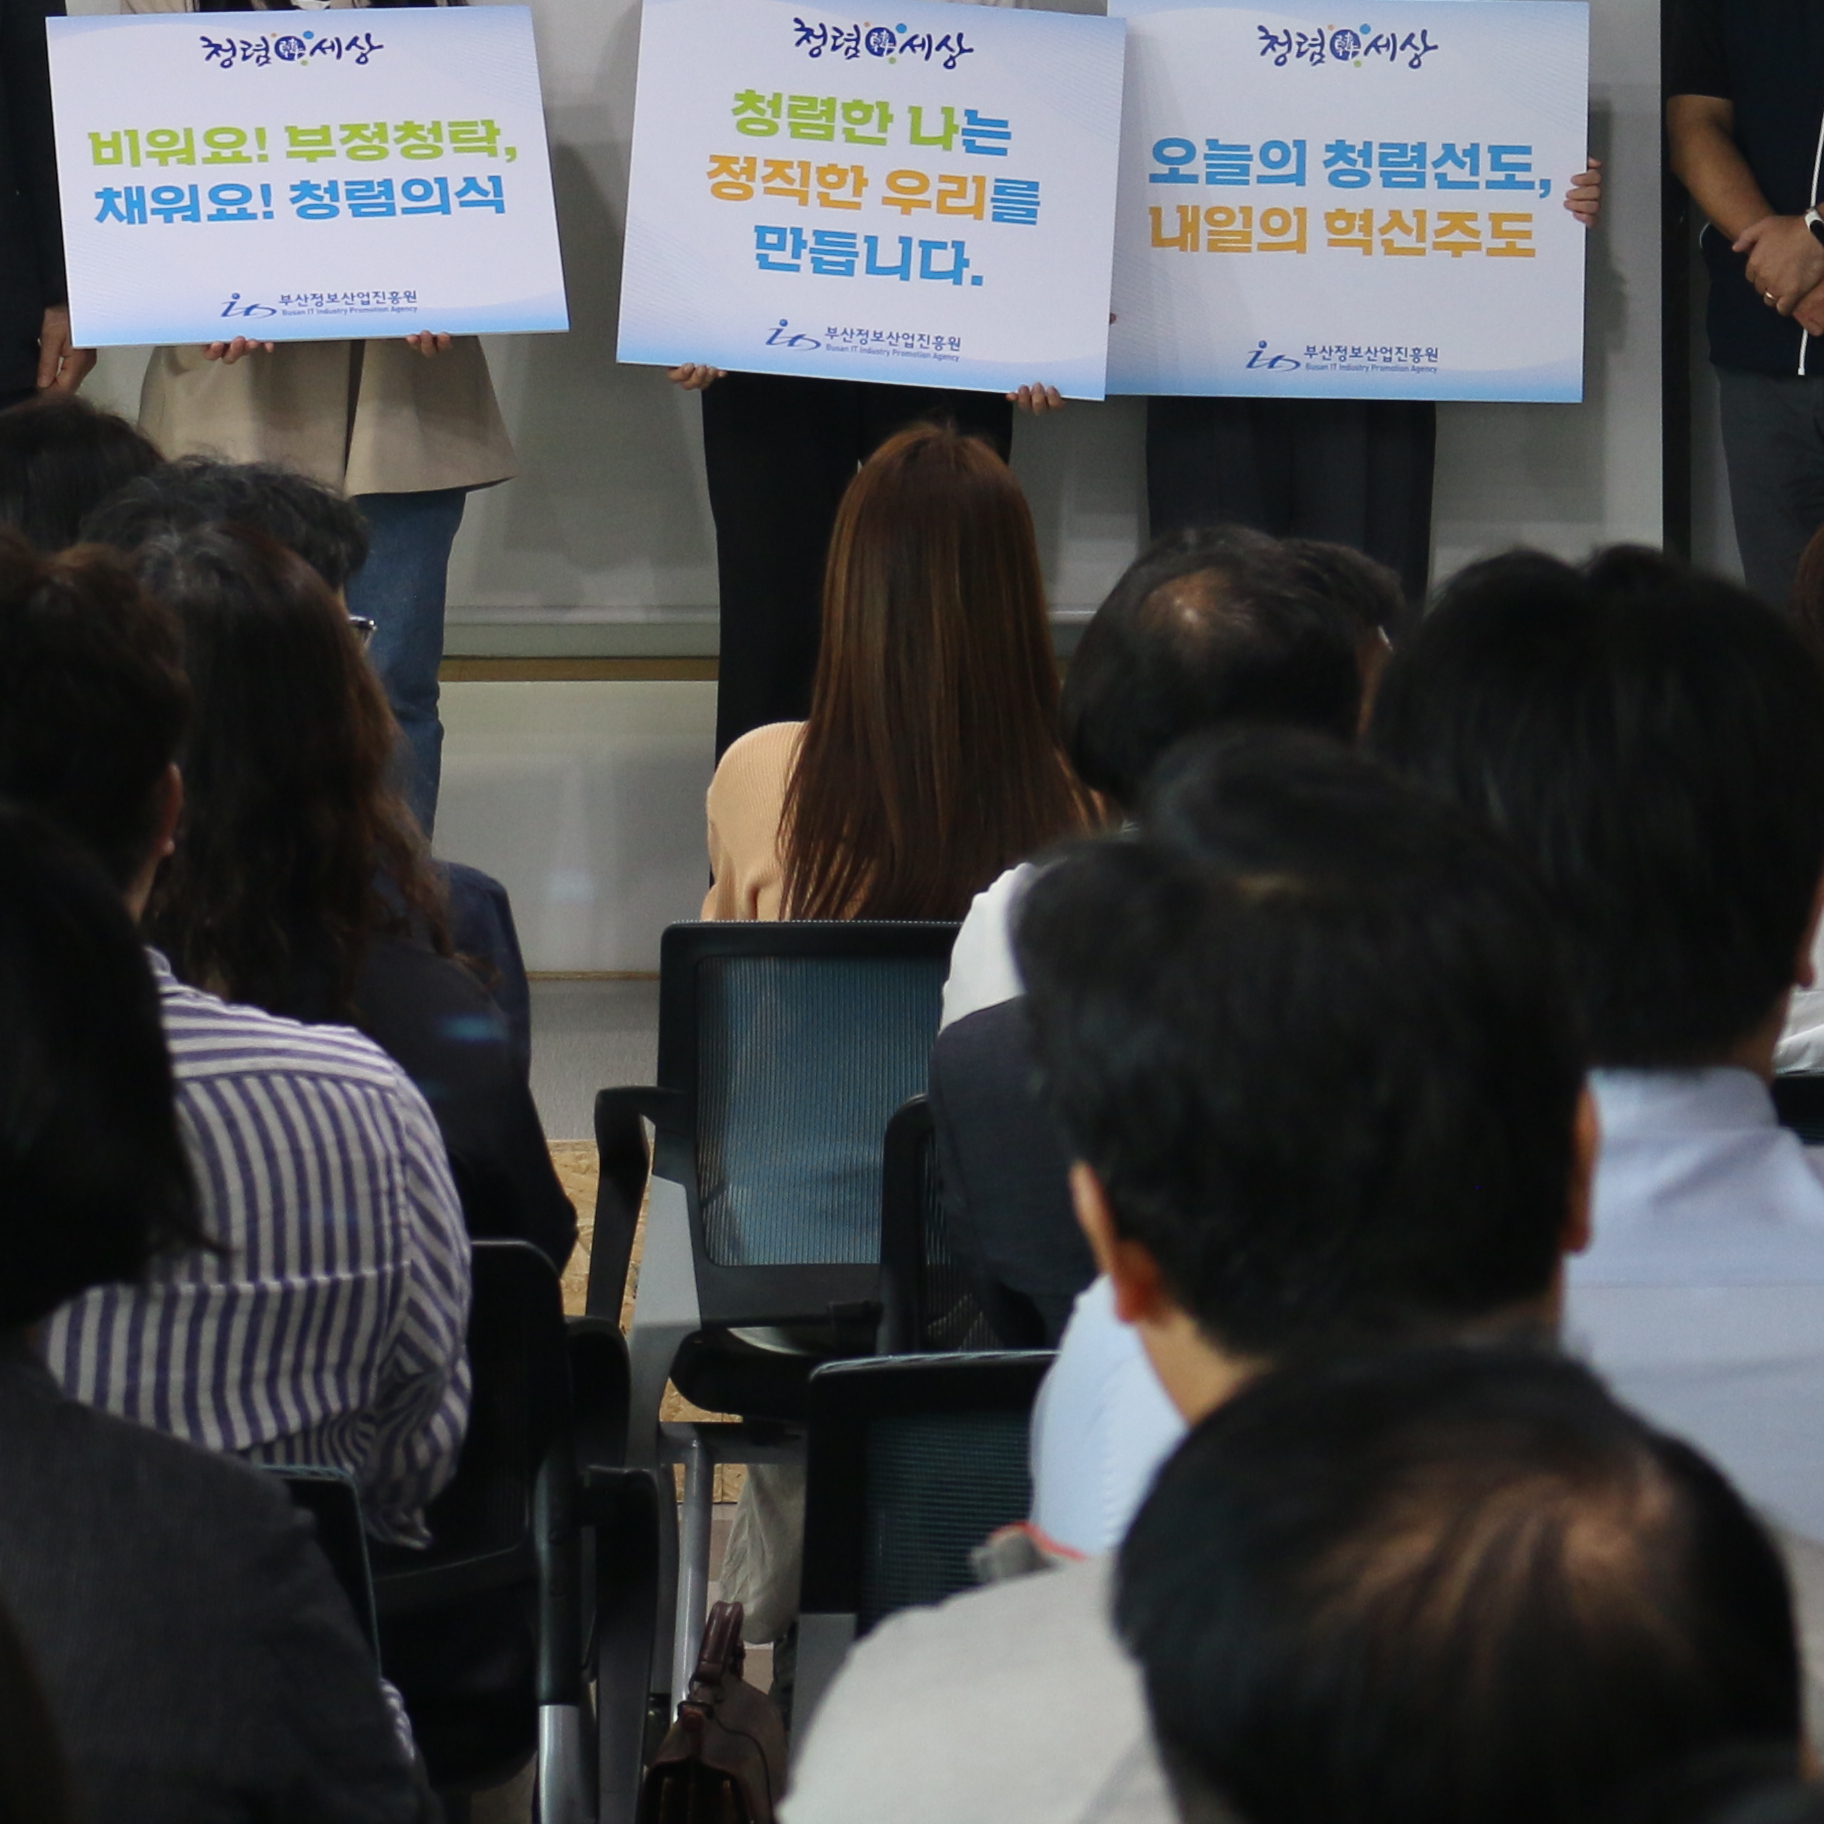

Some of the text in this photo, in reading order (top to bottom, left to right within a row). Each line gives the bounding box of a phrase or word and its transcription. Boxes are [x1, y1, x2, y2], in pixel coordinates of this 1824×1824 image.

[88, 119, 517, 167] 비워요! 부정청탁,
[731, 89, 1012, 157] 청렴한 나는
[707, 154, 1041, 226] 정직한 우리를
[1148, 137, 1551, 199] 오늘의 청렴선도,
[95, 175, 506, 225] 채워요! 청렴의식
[754, 224, 983, 287] 만듭니다.
[1148, 205, 1536, 257] 내일의 혁신주도
[279, 290, 417, 307] 부산정보산업진흥원
[825, 326, 961, 352] 부산정보산업진흥원
[1303, 345, 1438, 363] 부산정보산업진흥원
